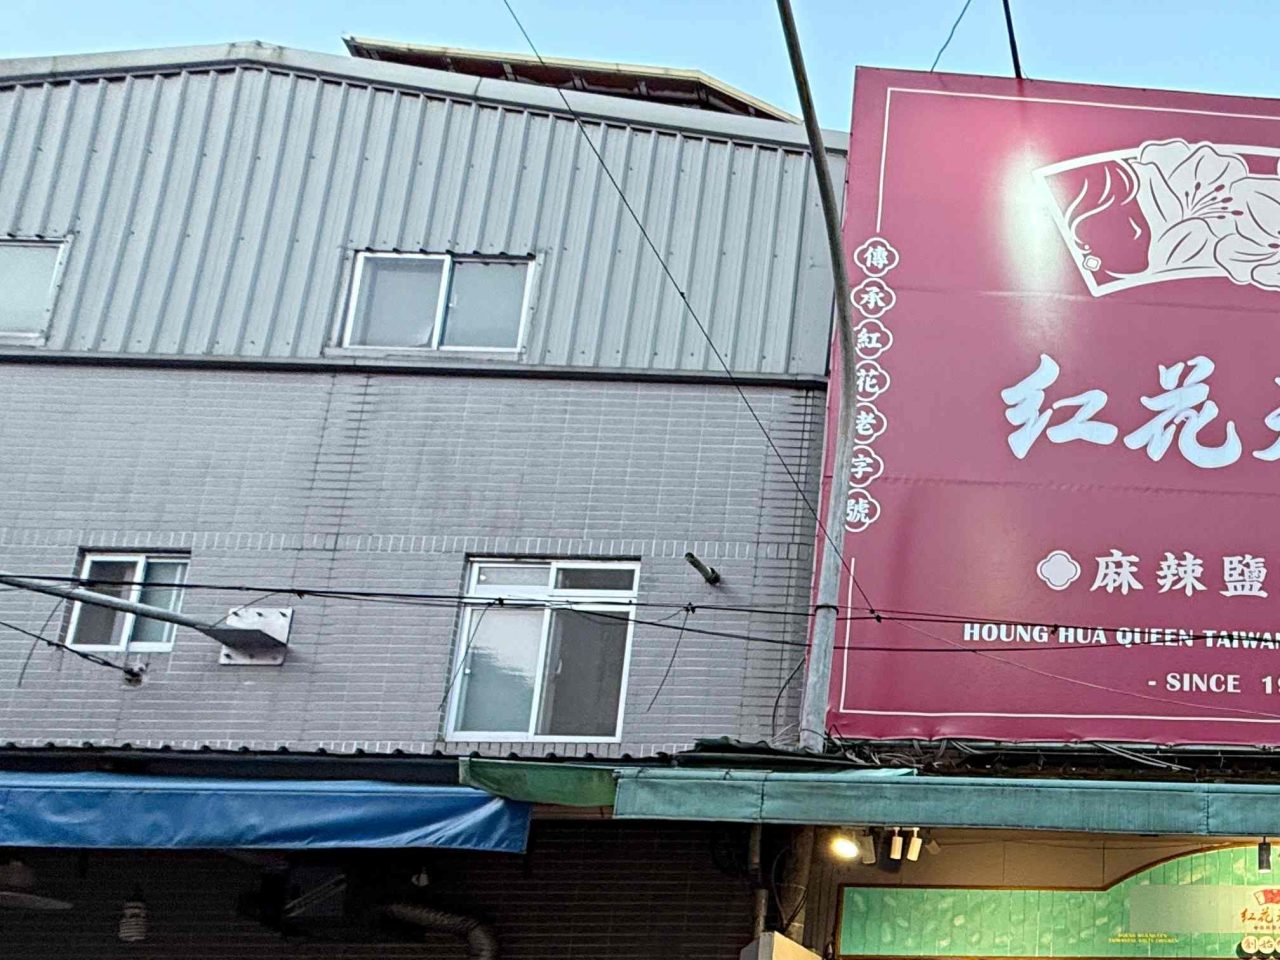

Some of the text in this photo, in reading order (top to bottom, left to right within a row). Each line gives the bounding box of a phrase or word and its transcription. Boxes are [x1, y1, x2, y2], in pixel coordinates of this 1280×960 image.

[846, 246, 890, 523] 傳承紅花老字號
[963, 624, 1049, 643] HOUNG
[1058, 627, 1107, 645] HUA
[1116, 627, 1193, 648] QUEEN
[1165, 673, 1241, 694] SINCE
